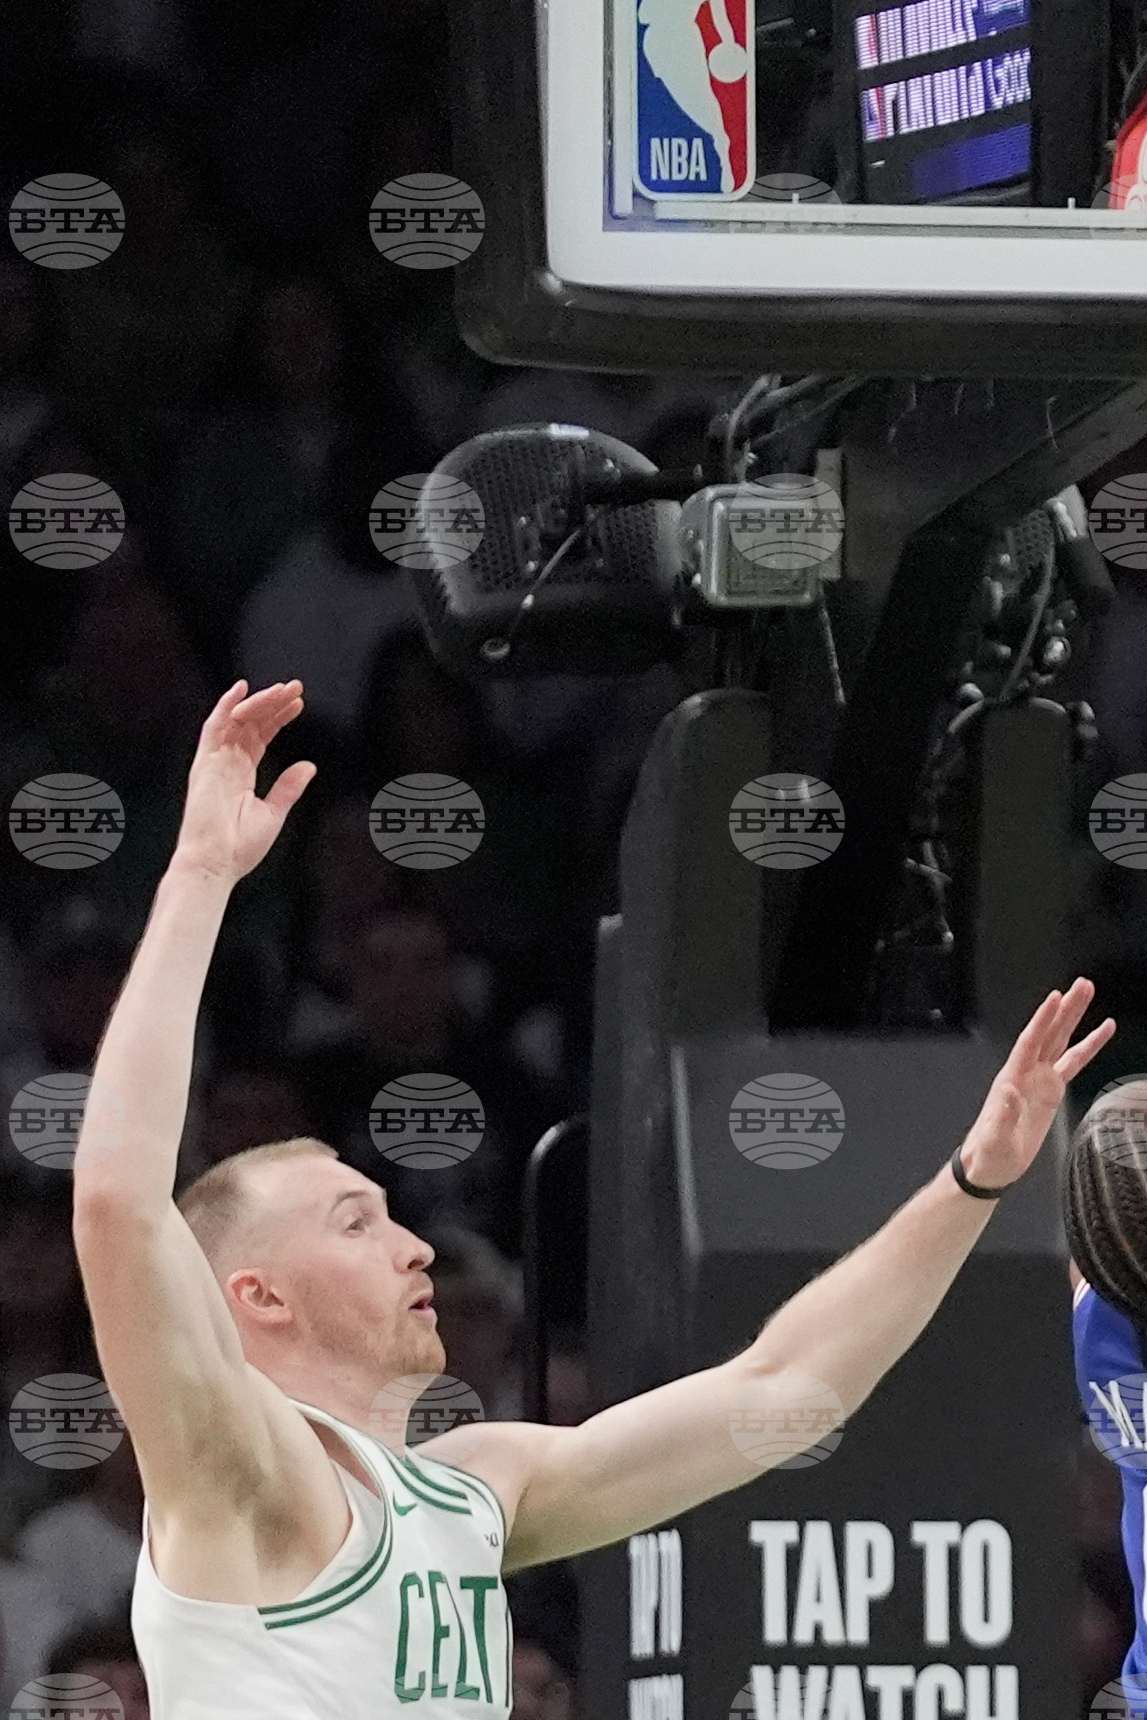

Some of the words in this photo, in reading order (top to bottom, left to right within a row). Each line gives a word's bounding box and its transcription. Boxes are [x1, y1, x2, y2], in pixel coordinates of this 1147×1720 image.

[650, 137, 707, 181] NBA
[394, 1570, 510, 1709] CELT
[748, 1519, 895, 1647] TAP
[910, 1518, 1013, 1647] TO
